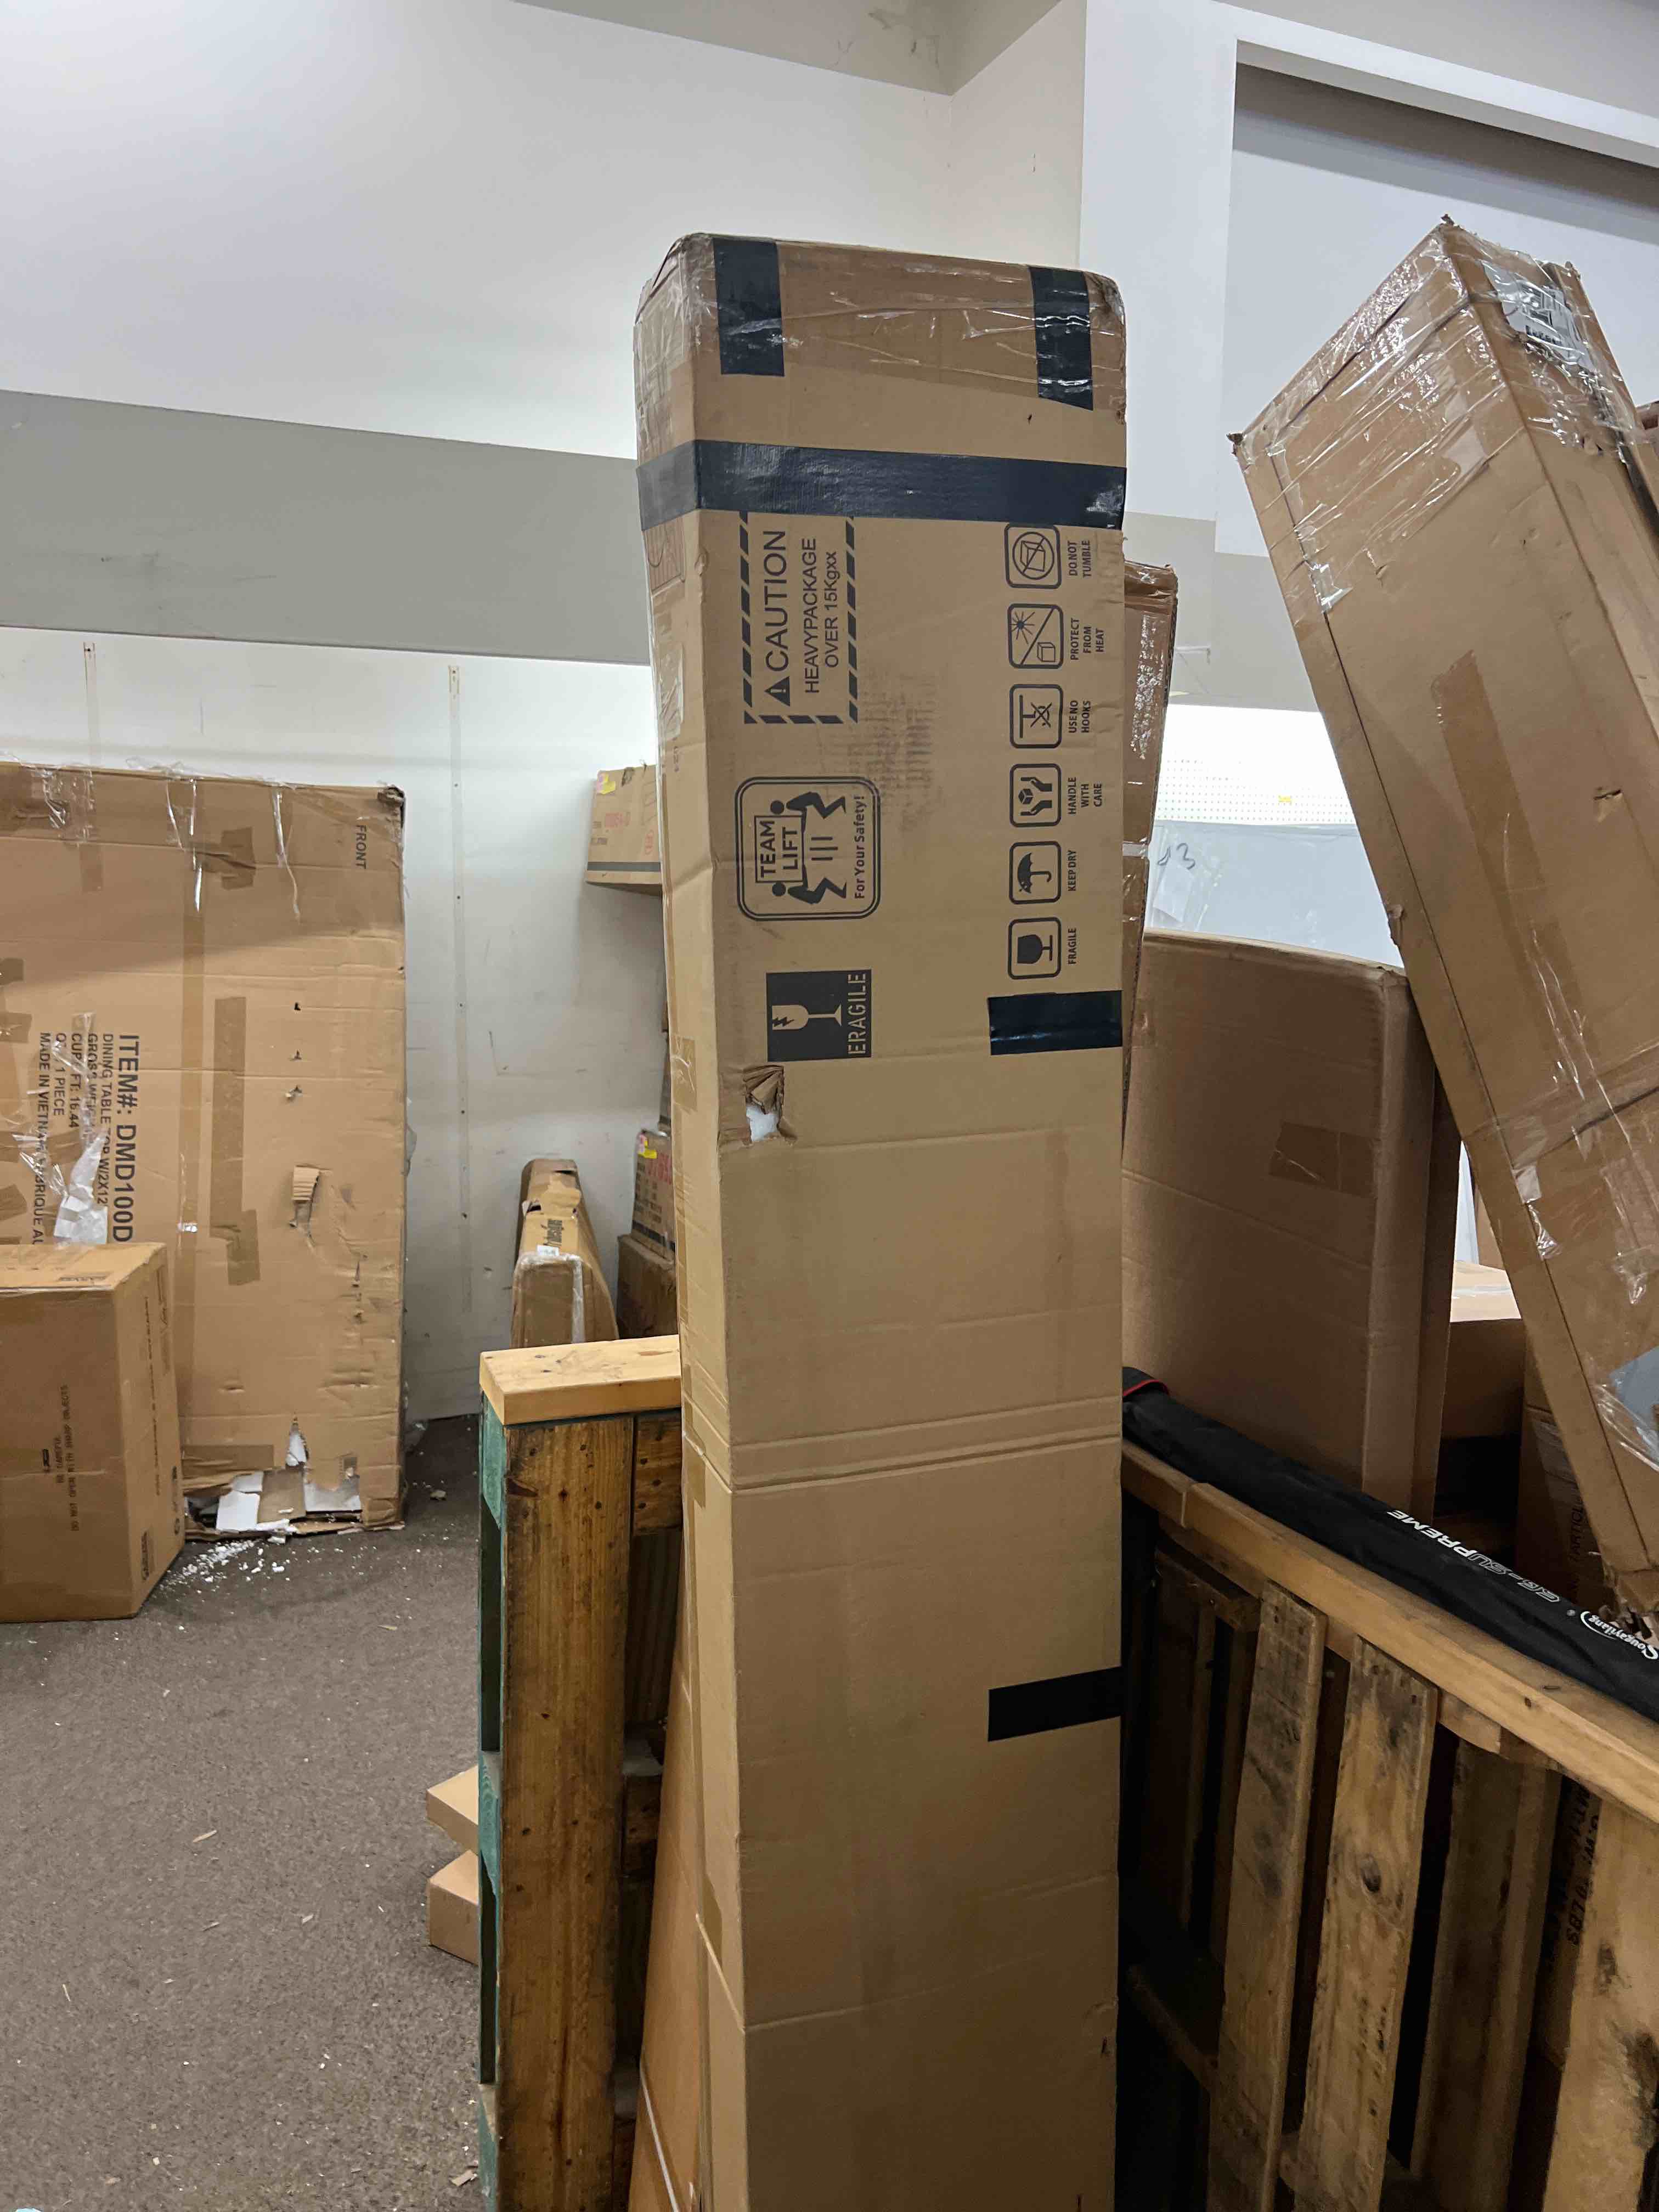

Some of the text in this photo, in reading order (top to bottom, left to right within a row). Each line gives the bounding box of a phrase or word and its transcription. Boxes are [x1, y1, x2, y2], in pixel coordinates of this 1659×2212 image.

[1068, 541, 1078, 576] DO NOT
[1082, 540, 1092, 577] TUMBLE
[763, 531, 789, 672] CAUTION
[802, 538, 819, 693] HEAVYPACKAGE
[824, 551, 840, 667] OVER 15Kgxx
[1070, 618, 1080, 660] PROTECT
[1083, 627, 1092, 653] FROM
[1096, 628, 1104, 652] HEAT
[1068, 700, 1079, 733] USE NO
[1081, 700, 1091, 733] HOOKS
[1068, 776, 1077, 815] HANDLE
[1081, 783, 1089, 808] WITH
[1093, 783, 1102, 807] CARE
[356, 824, 367, 870] FRONT
[759, 821, 776, 878] TEAM
[782, 827, 798, 870] LIFT
[853, 796, 867, 899] For Your Safety!
[1068, 850, 1077, 891] KEEP DRY
[1068, 928, 1077, 965] FRAGILE
[40, 1032, 50, 1070] MADE
[102, 1034, 114, 1079] DINING
[38, 1075, 50, 1087] IN
[53, 1077, 65, 1116] PIECE
[69, 1097, 81, 1128] 16.44
[100, 1082, 112, 1124] TABLE
[112, 1035, 140, 1242] ITEM#: DMD100D
[34, 1159, 46, 1226] BRIQUE
[1587, 1614, 1658, 1660] Sougayilang
